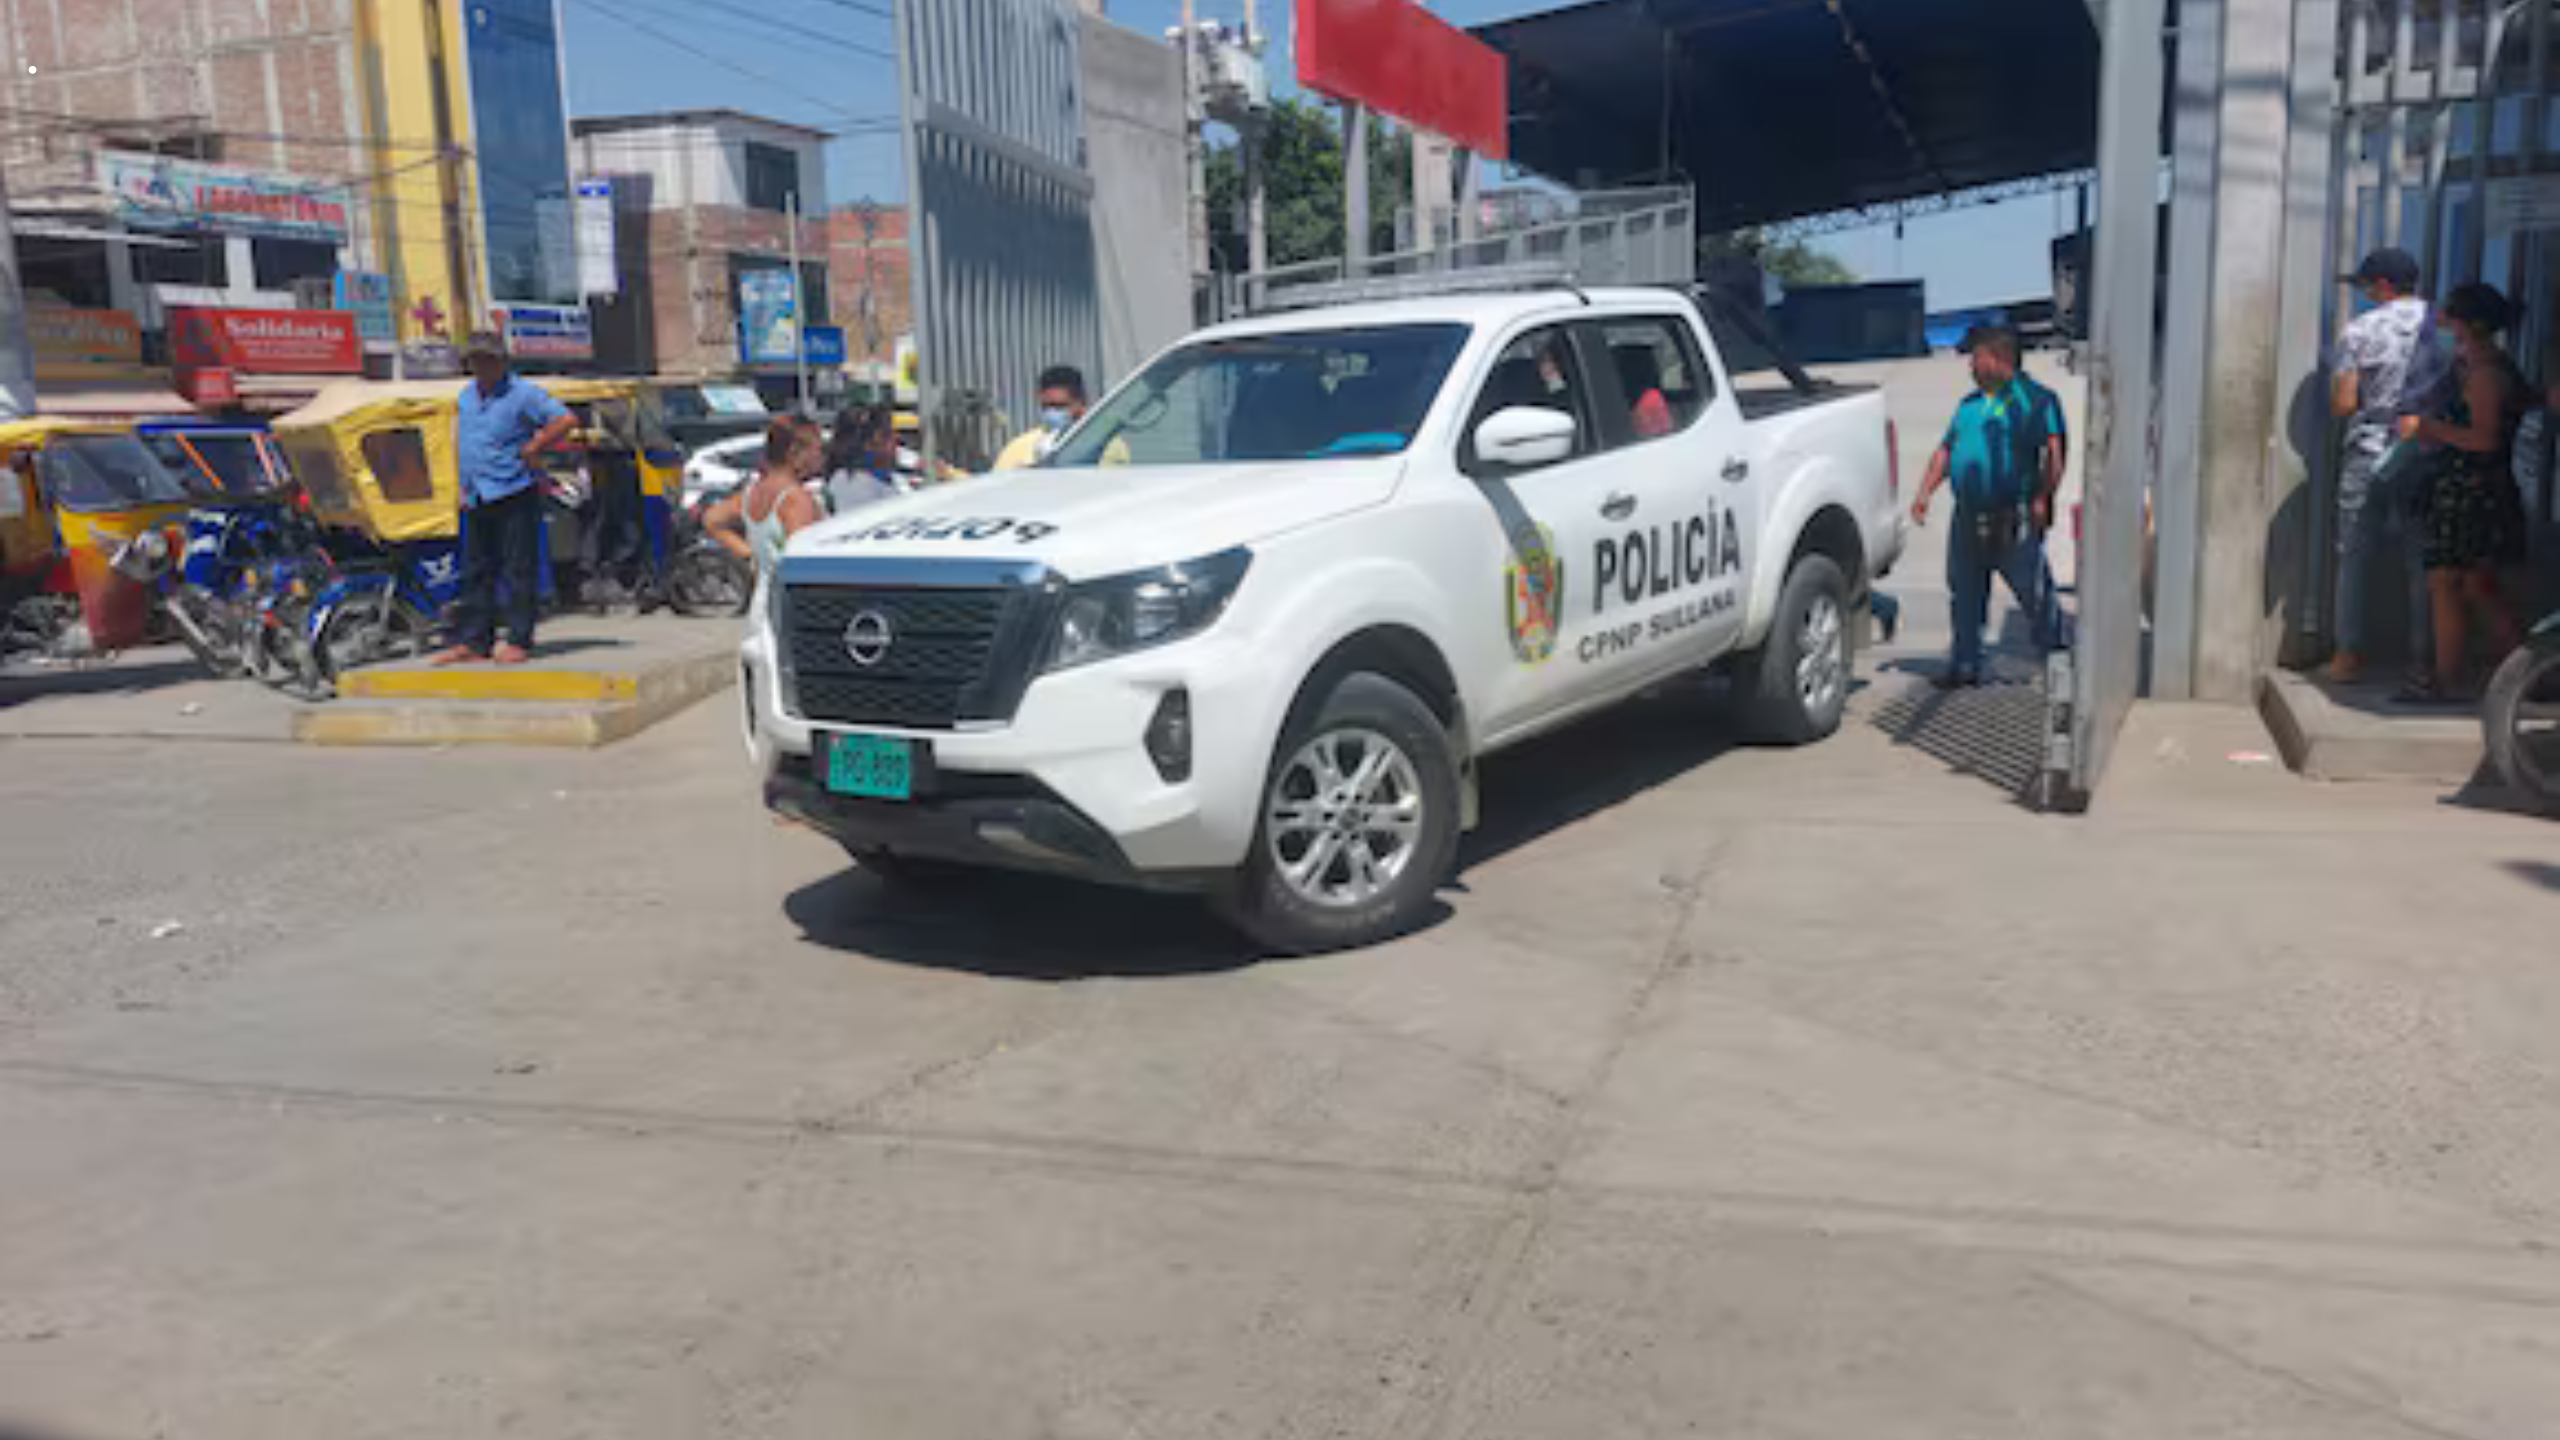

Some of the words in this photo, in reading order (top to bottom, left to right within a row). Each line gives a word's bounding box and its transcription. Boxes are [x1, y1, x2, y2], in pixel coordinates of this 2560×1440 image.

[225, 317, 345, 338] Solidaria
[1593, 495, 1741, 615] POLICÍA
[1577, 622, 1642, 663] CPNP
[1649, 587, 1737, 640] SULLANA
